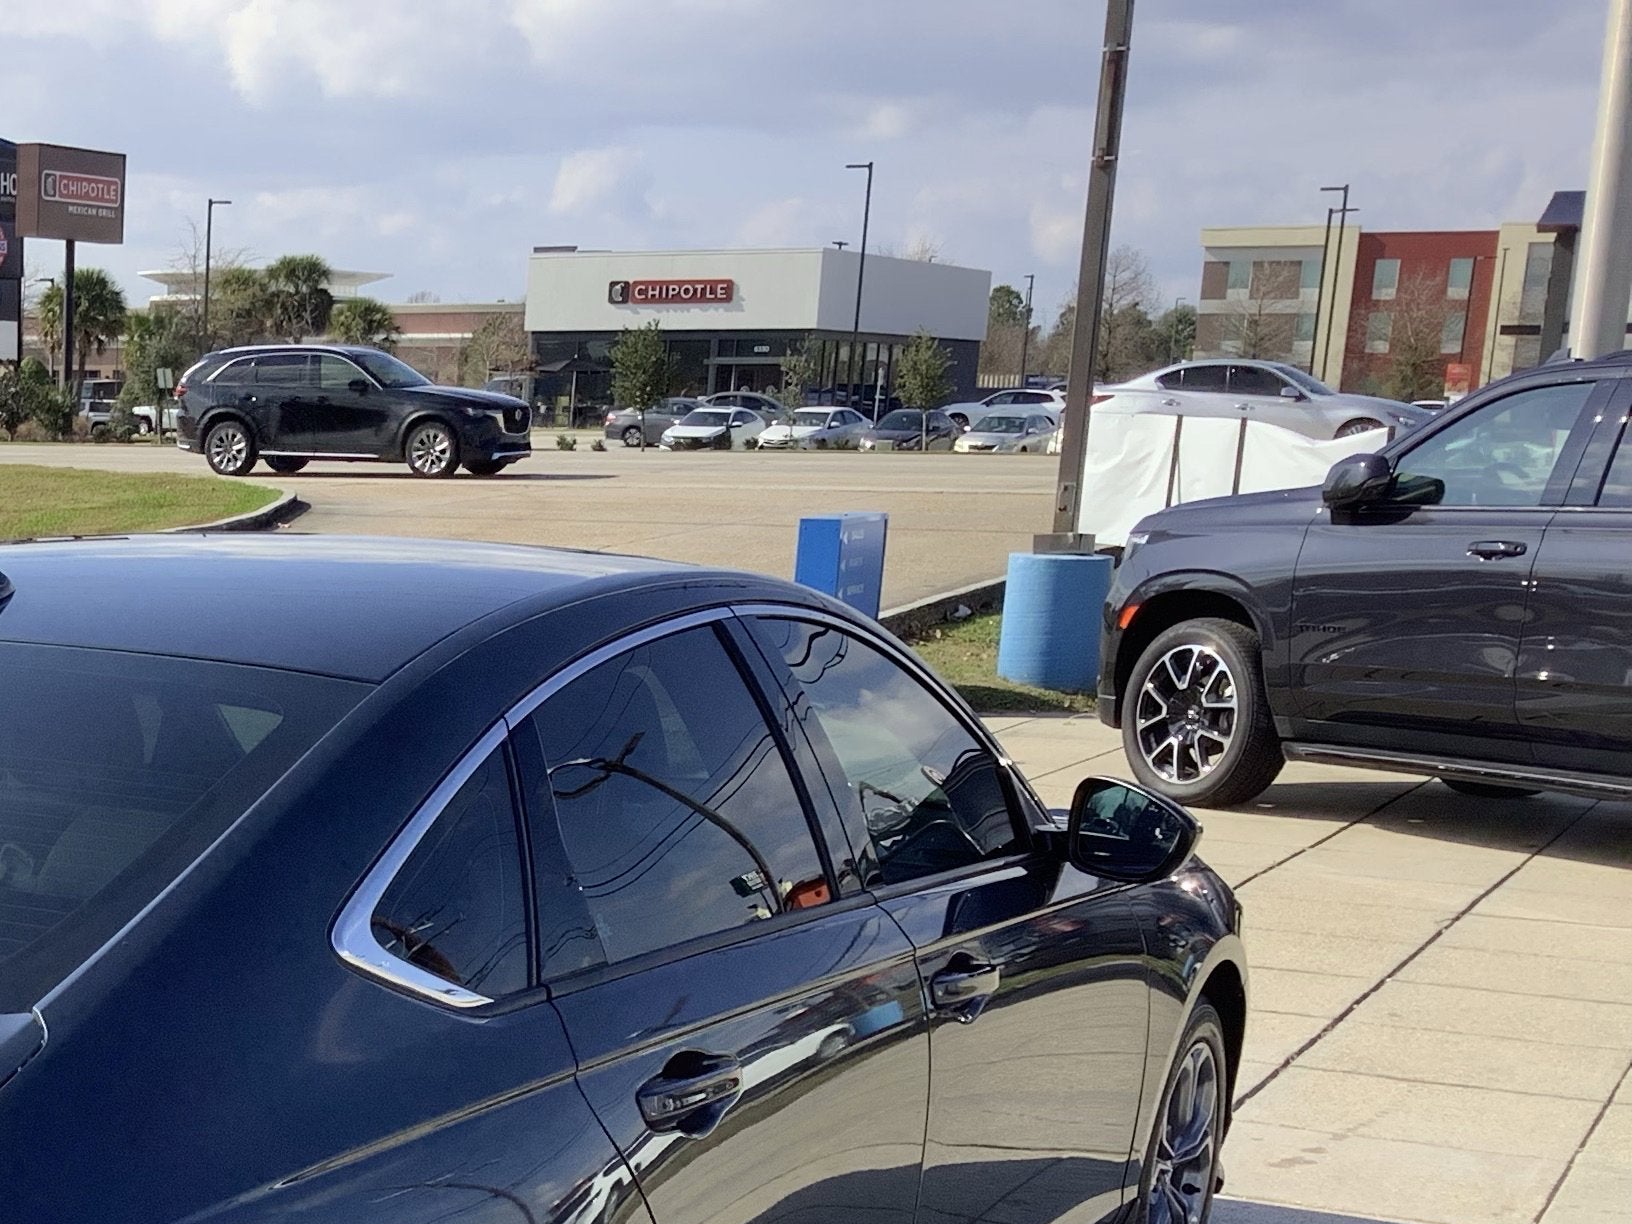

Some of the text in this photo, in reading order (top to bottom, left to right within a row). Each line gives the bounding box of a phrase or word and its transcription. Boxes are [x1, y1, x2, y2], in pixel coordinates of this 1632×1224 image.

[0, 172, 17, 195] HO
[60, 180, 117, 200] CHIPOTLE
[68, 205, 116, 218] MEXICAN GRILL
[634, 284, 728, 299] CHIPOTLE
